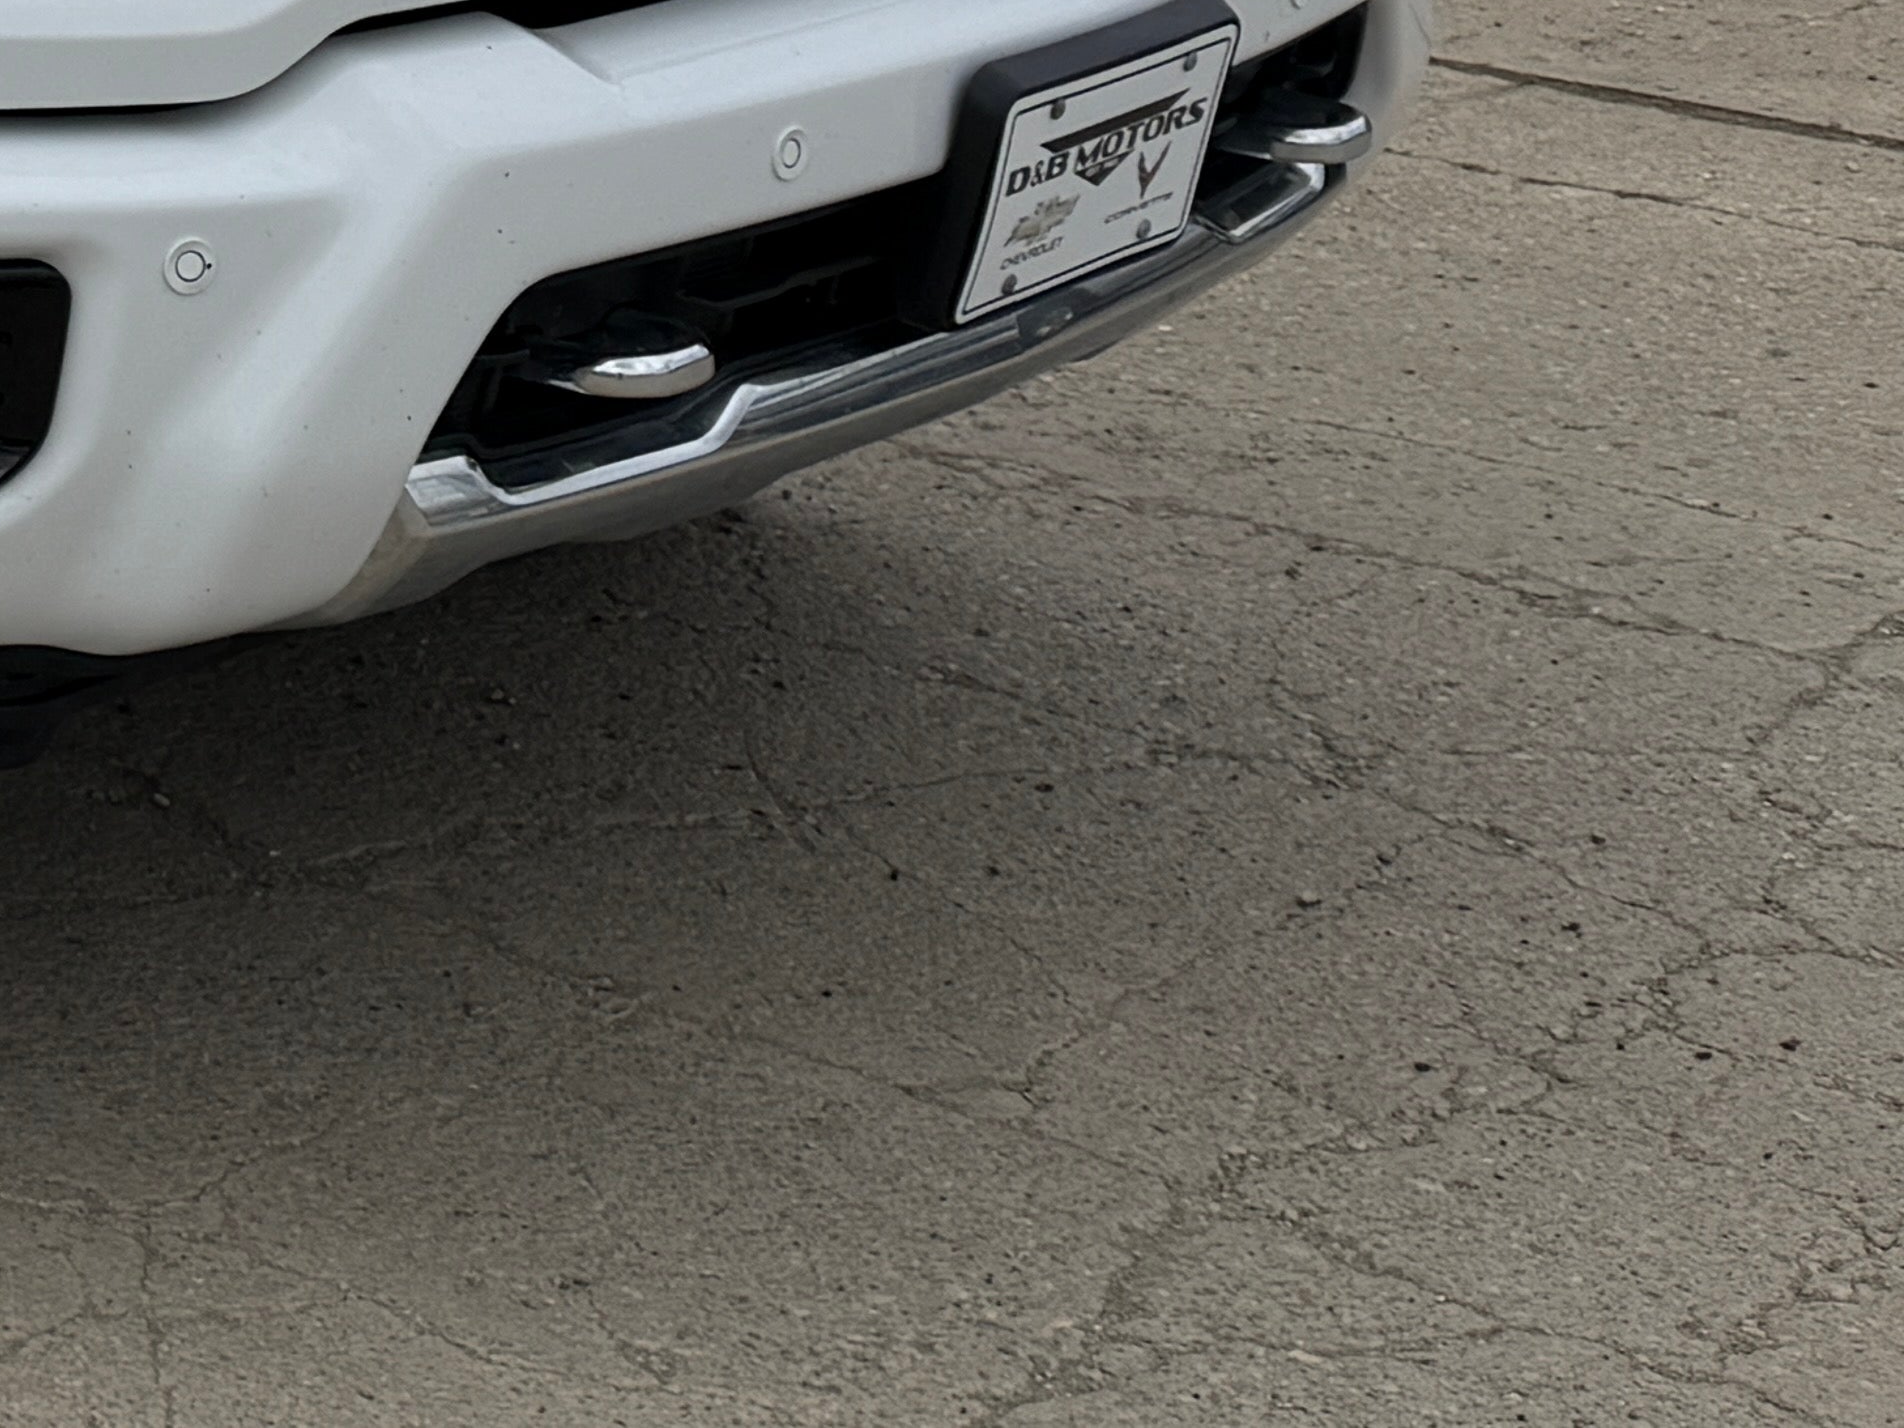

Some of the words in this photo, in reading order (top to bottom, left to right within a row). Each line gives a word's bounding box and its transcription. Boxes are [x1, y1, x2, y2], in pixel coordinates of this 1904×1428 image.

[1006, 151, 1069, 197] D&B
[1073, 97, 1208, 170] MOTORS
[999, 235, 1065, 271] CHEVROLET
